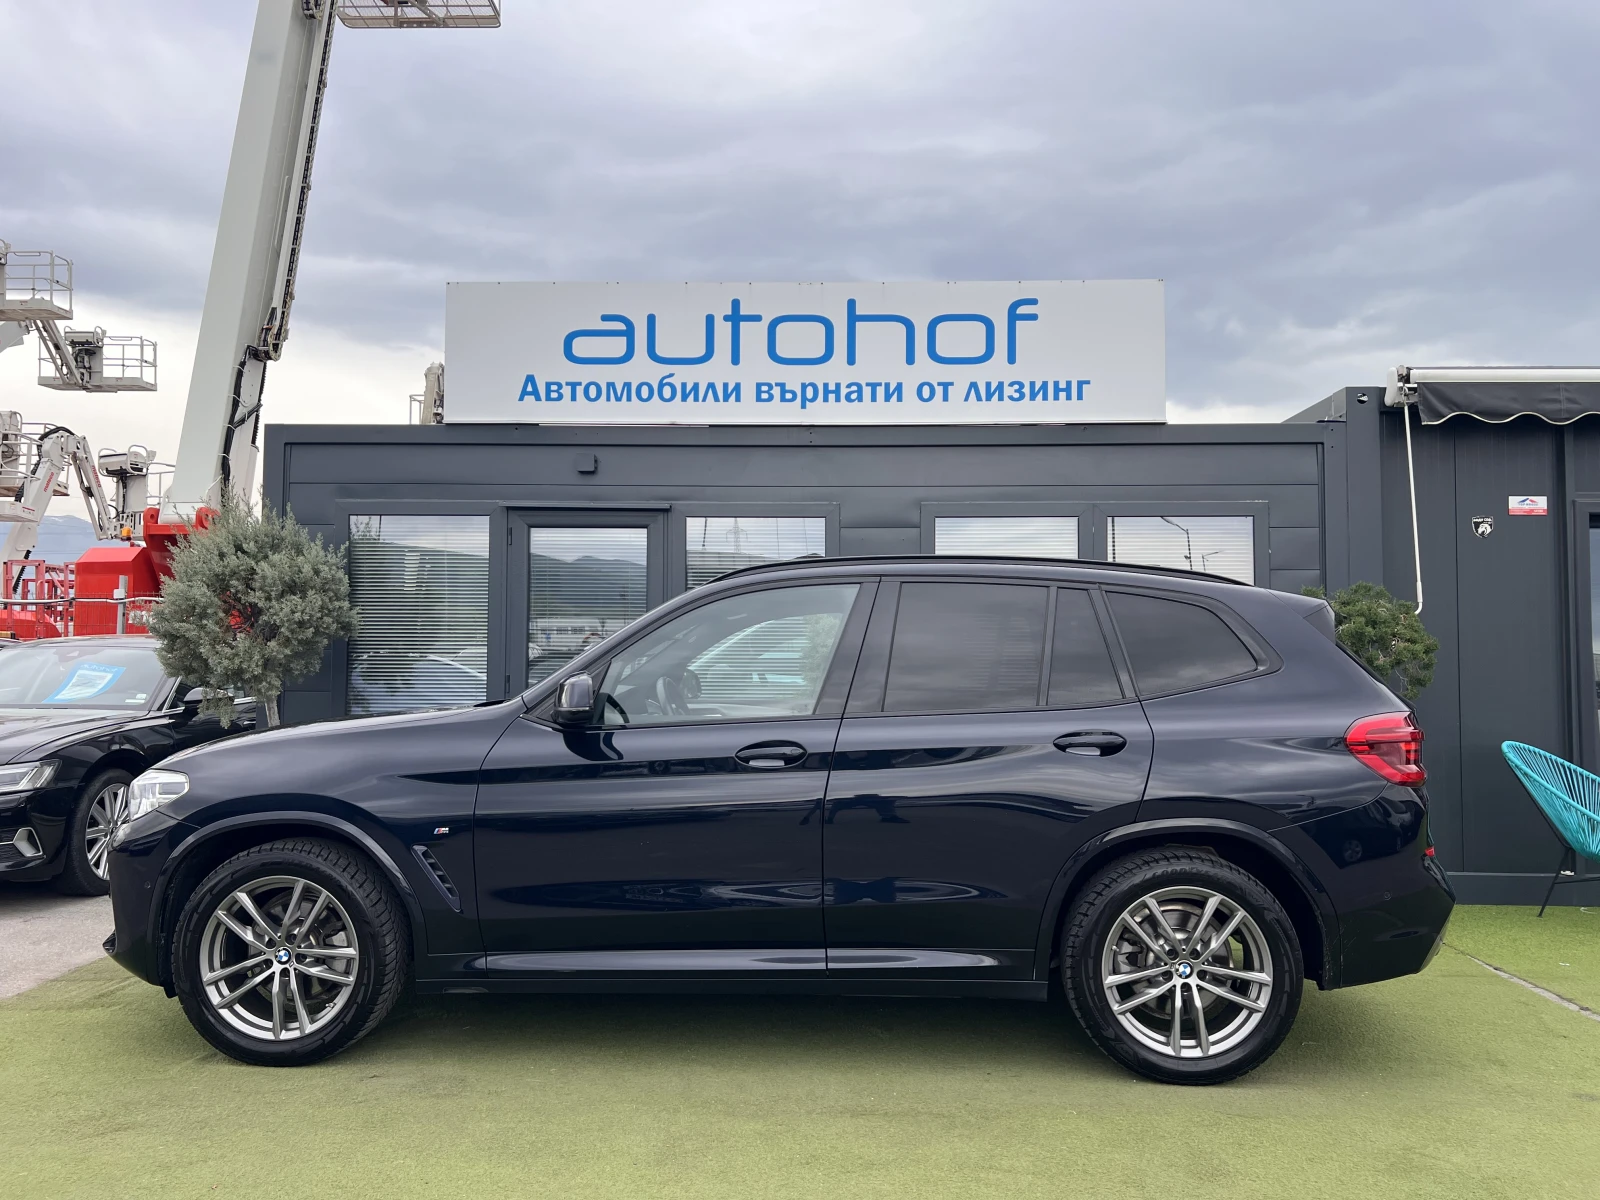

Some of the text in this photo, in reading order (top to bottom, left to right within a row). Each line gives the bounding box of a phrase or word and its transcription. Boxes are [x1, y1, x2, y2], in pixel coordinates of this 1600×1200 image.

[563, 297, 1039, 366] autohof
[518, 373, 1092, 410] Автомобили върнати от лизинг
